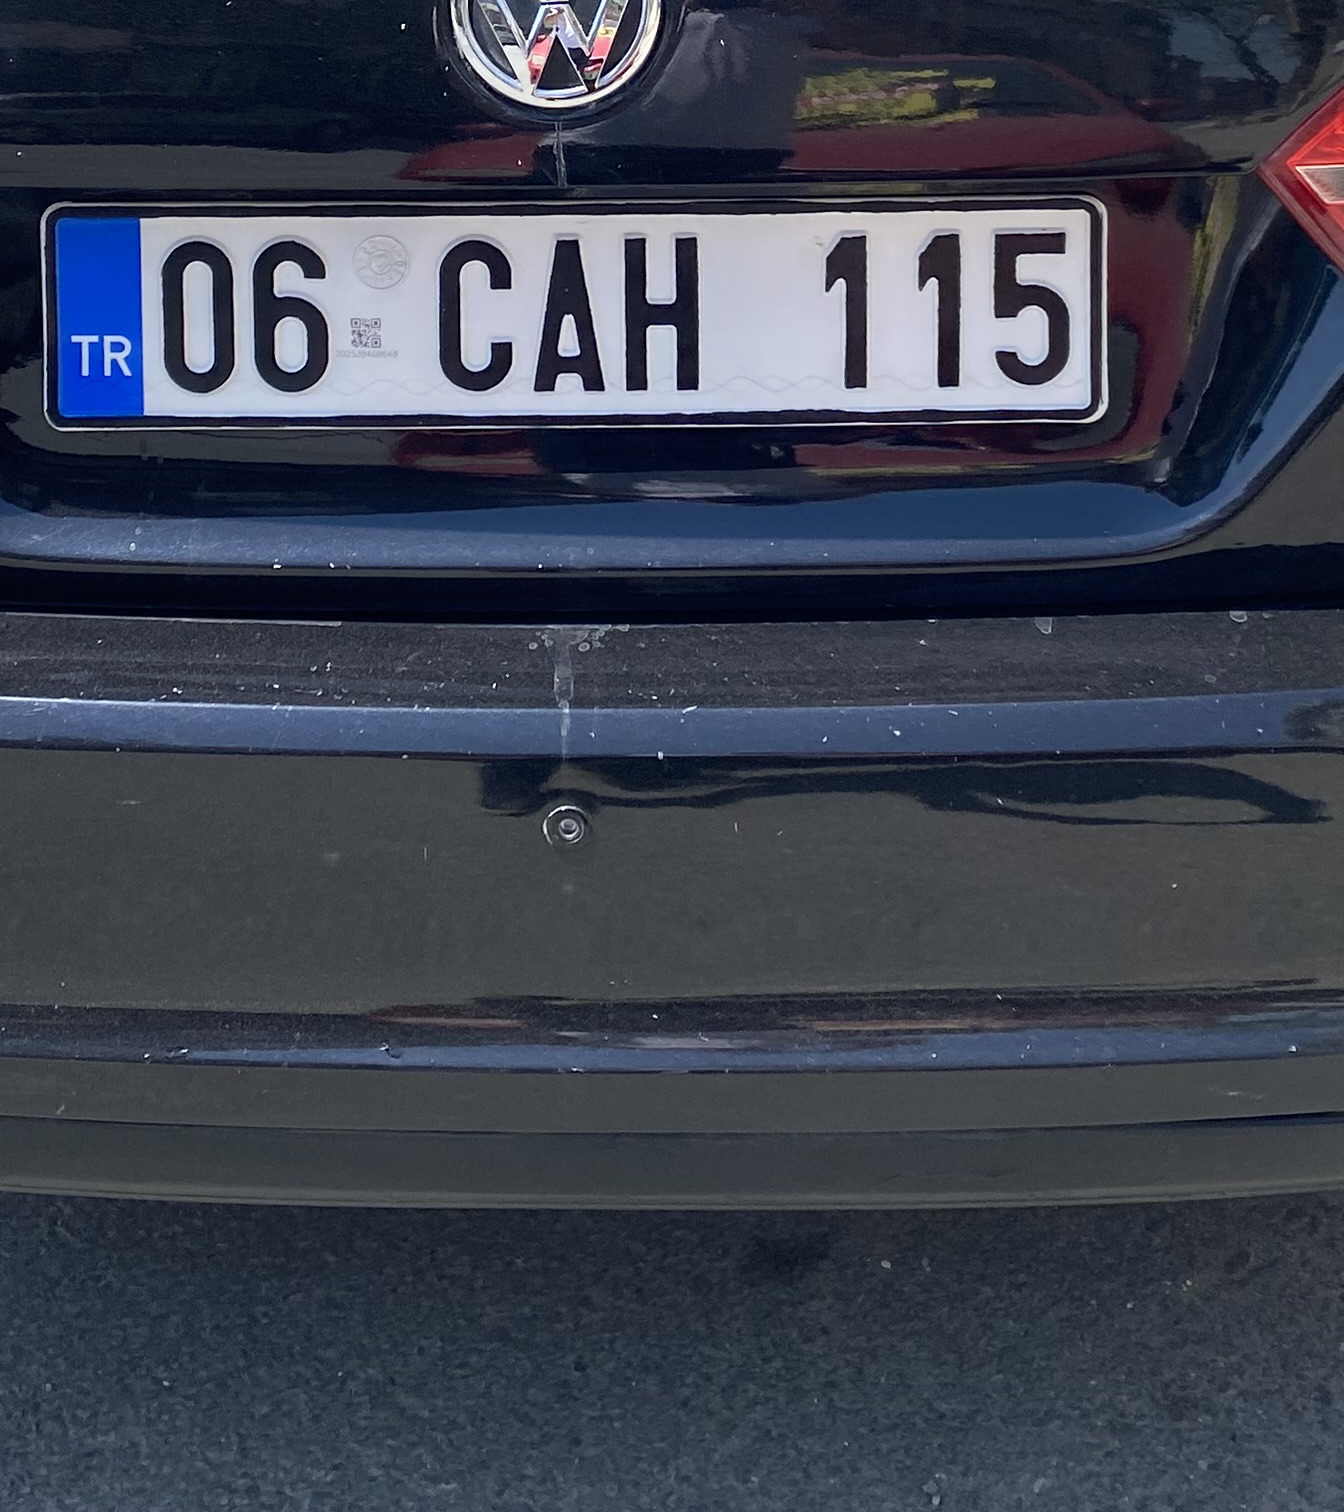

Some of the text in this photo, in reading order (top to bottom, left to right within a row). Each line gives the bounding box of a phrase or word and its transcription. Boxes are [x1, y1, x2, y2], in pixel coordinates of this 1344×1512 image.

[71, 231, 1072, 395] TR 06 CAH 115
